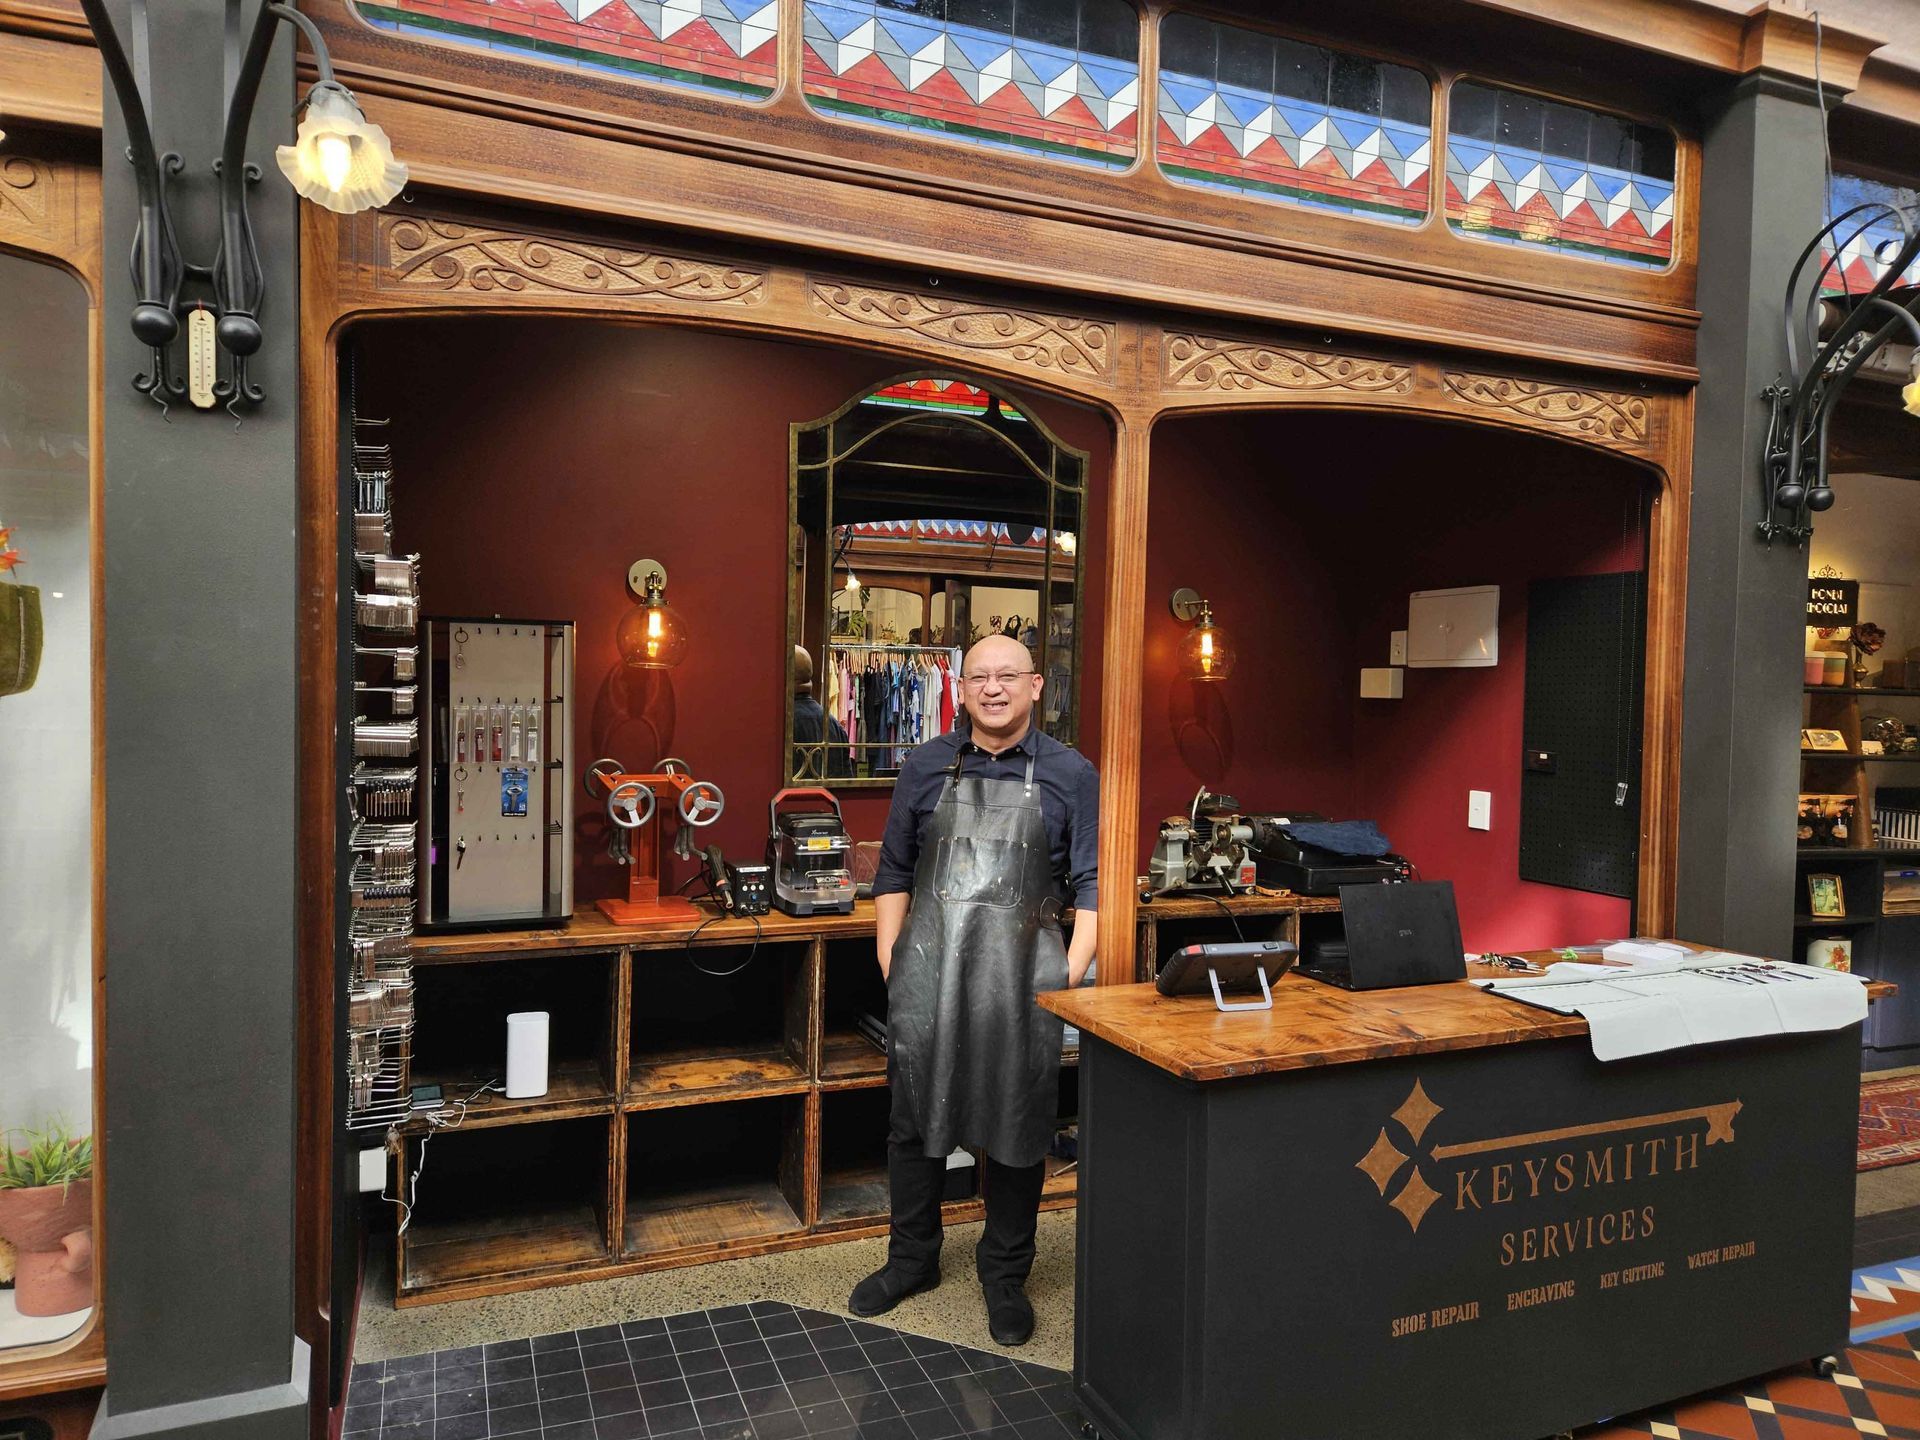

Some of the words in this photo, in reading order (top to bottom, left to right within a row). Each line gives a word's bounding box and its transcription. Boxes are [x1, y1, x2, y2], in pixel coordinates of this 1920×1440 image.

[1454, 1133, 1699, 1210] KEYSMITH
[1500, 1205, 1654, 1266] SERVICES
[1687, 1249, 1719, 1270] WATCH
[1722, 1240, 1755, 1262] REPAIR
[1600, 1271, 1619, 1289] KEY
[1622, 1261, 1665, 1285] CUTTING
[1506, 1279, 1576, 1312] ENGRAVING
[1391, 1312, 1427, 1338] SHOE
[1431, 1300, 1480, 1329] REPAIR
